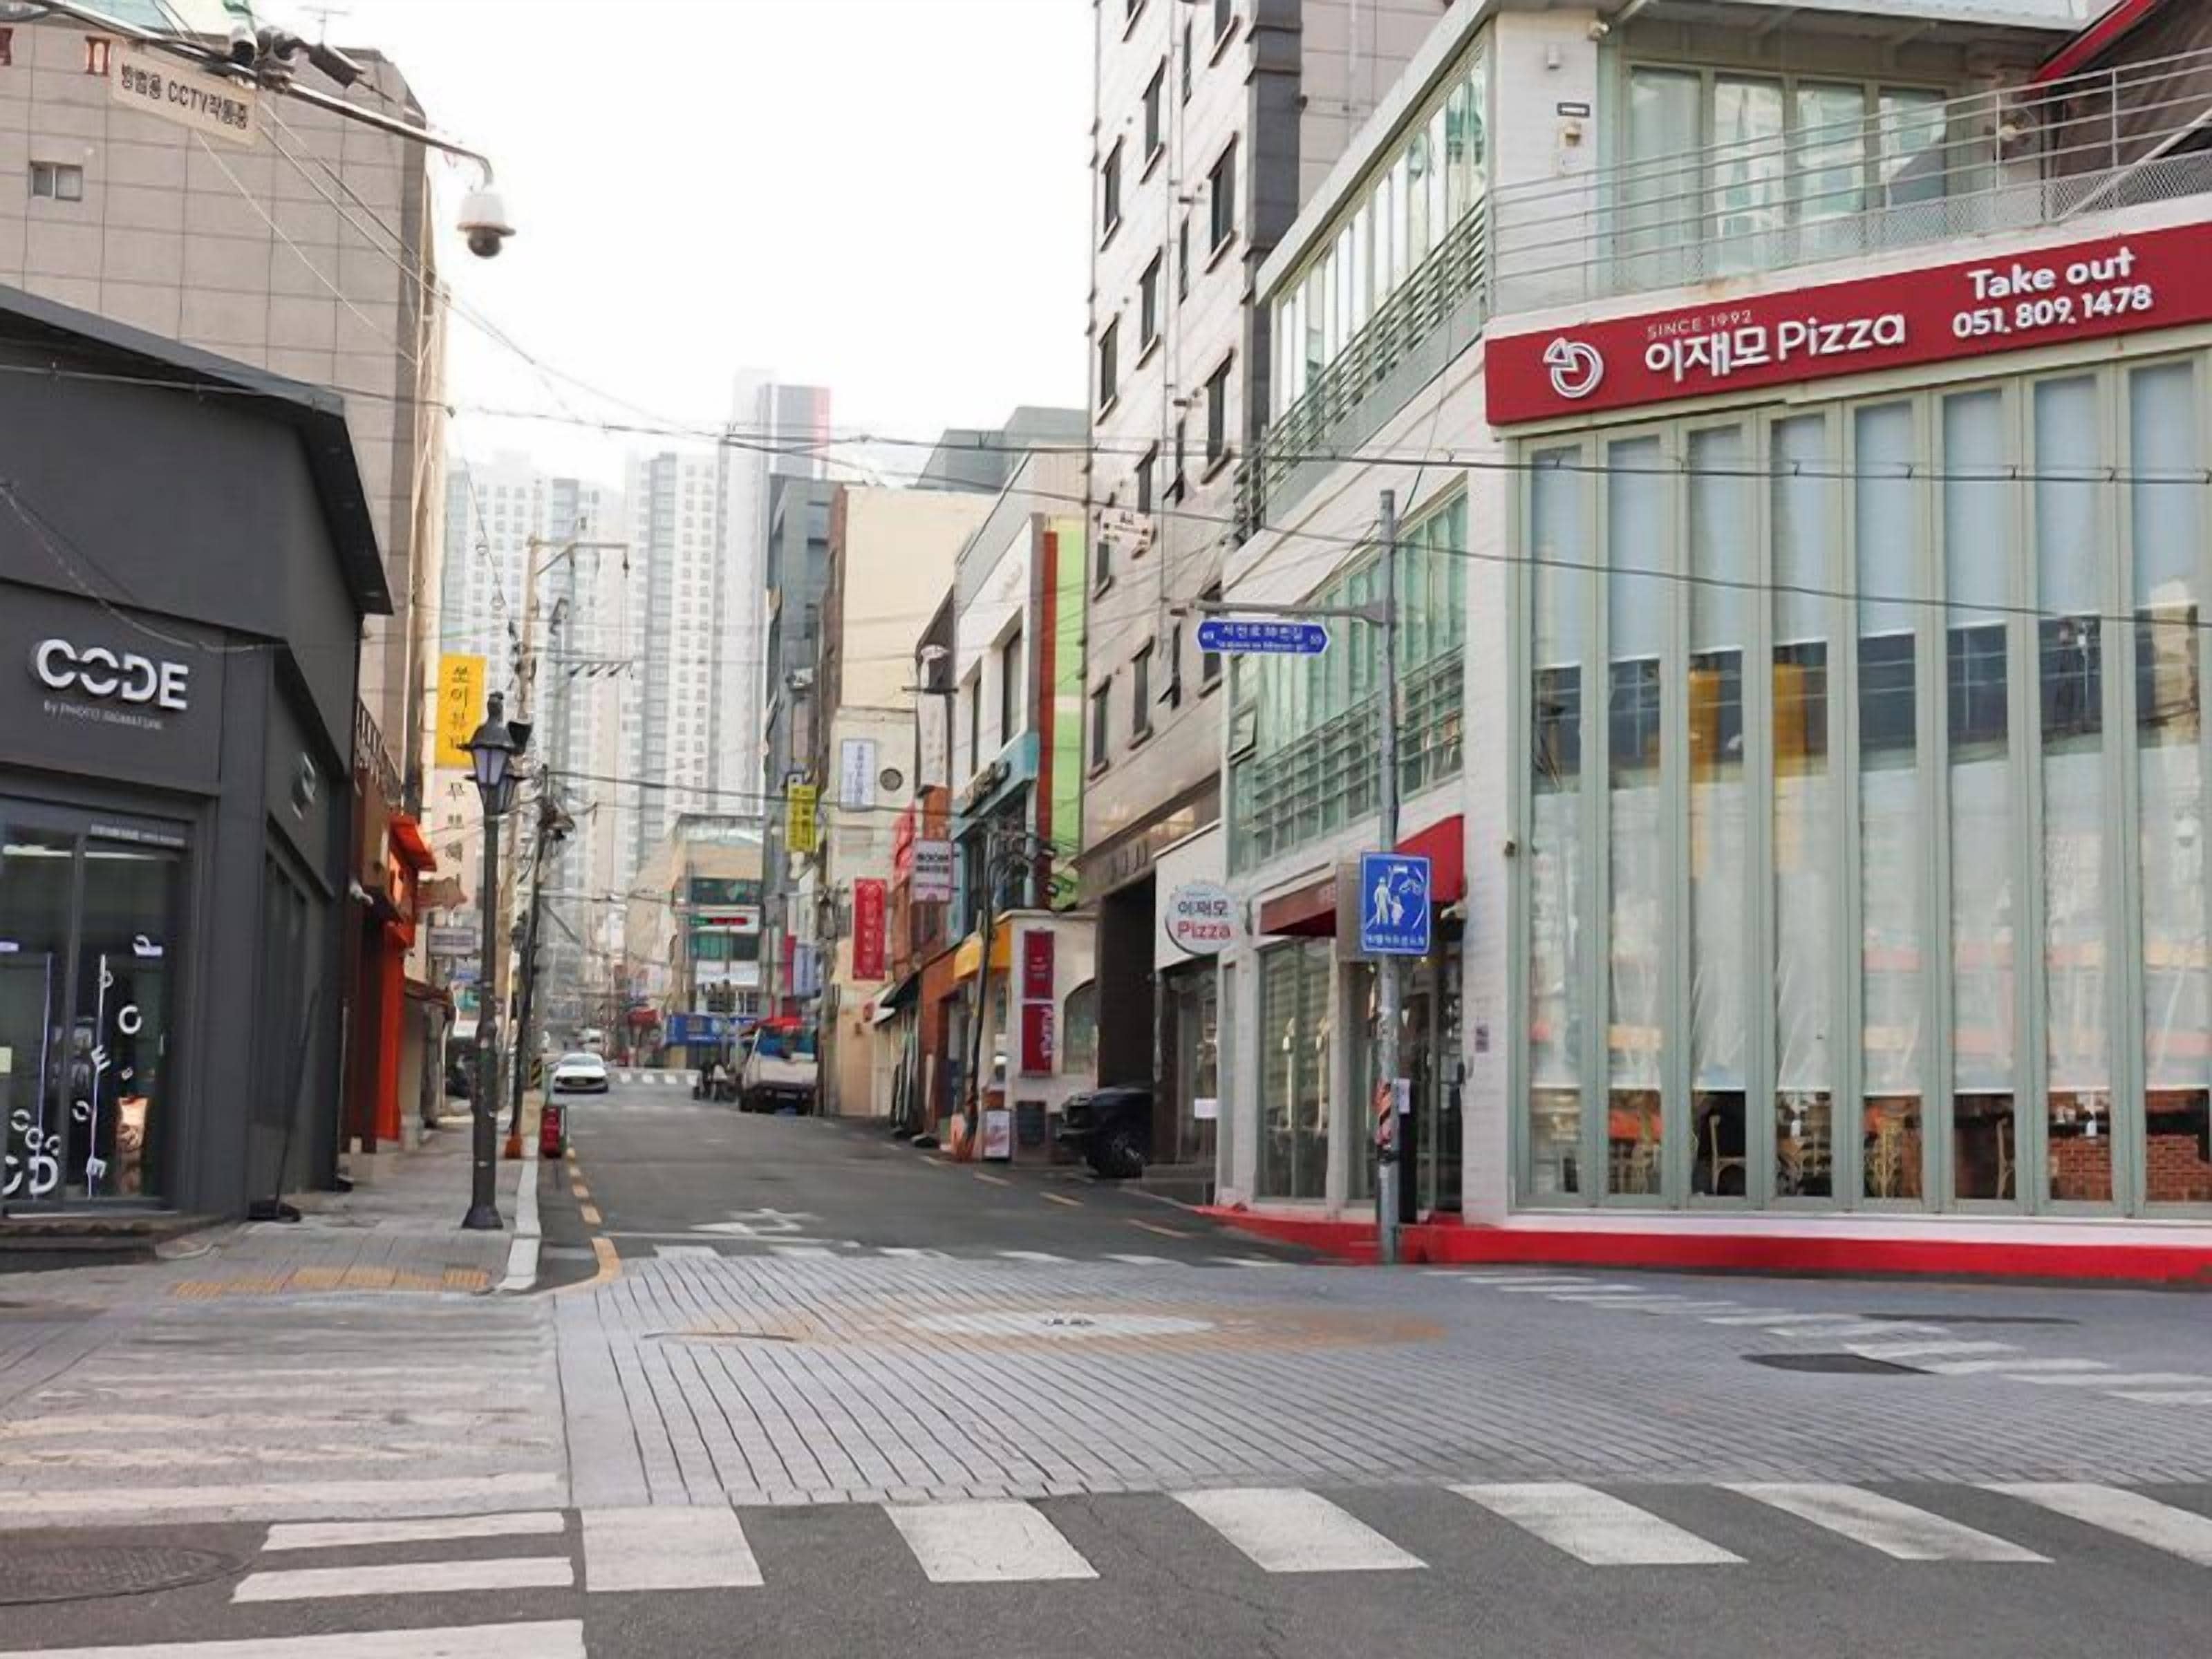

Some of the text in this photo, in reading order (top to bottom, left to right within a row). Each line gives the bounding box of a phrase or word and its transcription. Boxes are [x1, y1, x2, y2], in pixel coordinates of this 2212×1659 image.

[1967, 246, 2136, 301] Take out
[2081, 283, 2155, 319] 1478
[1646, 309, 1753, 341] SINCE 1992
[1644, 312, 1906, 383] 이재모 Pizza
[36, 638, 189, 711] CODE
[1177, 899, 1230, 918] 이재모
[1177, 920, 1231, 940] Pizza
